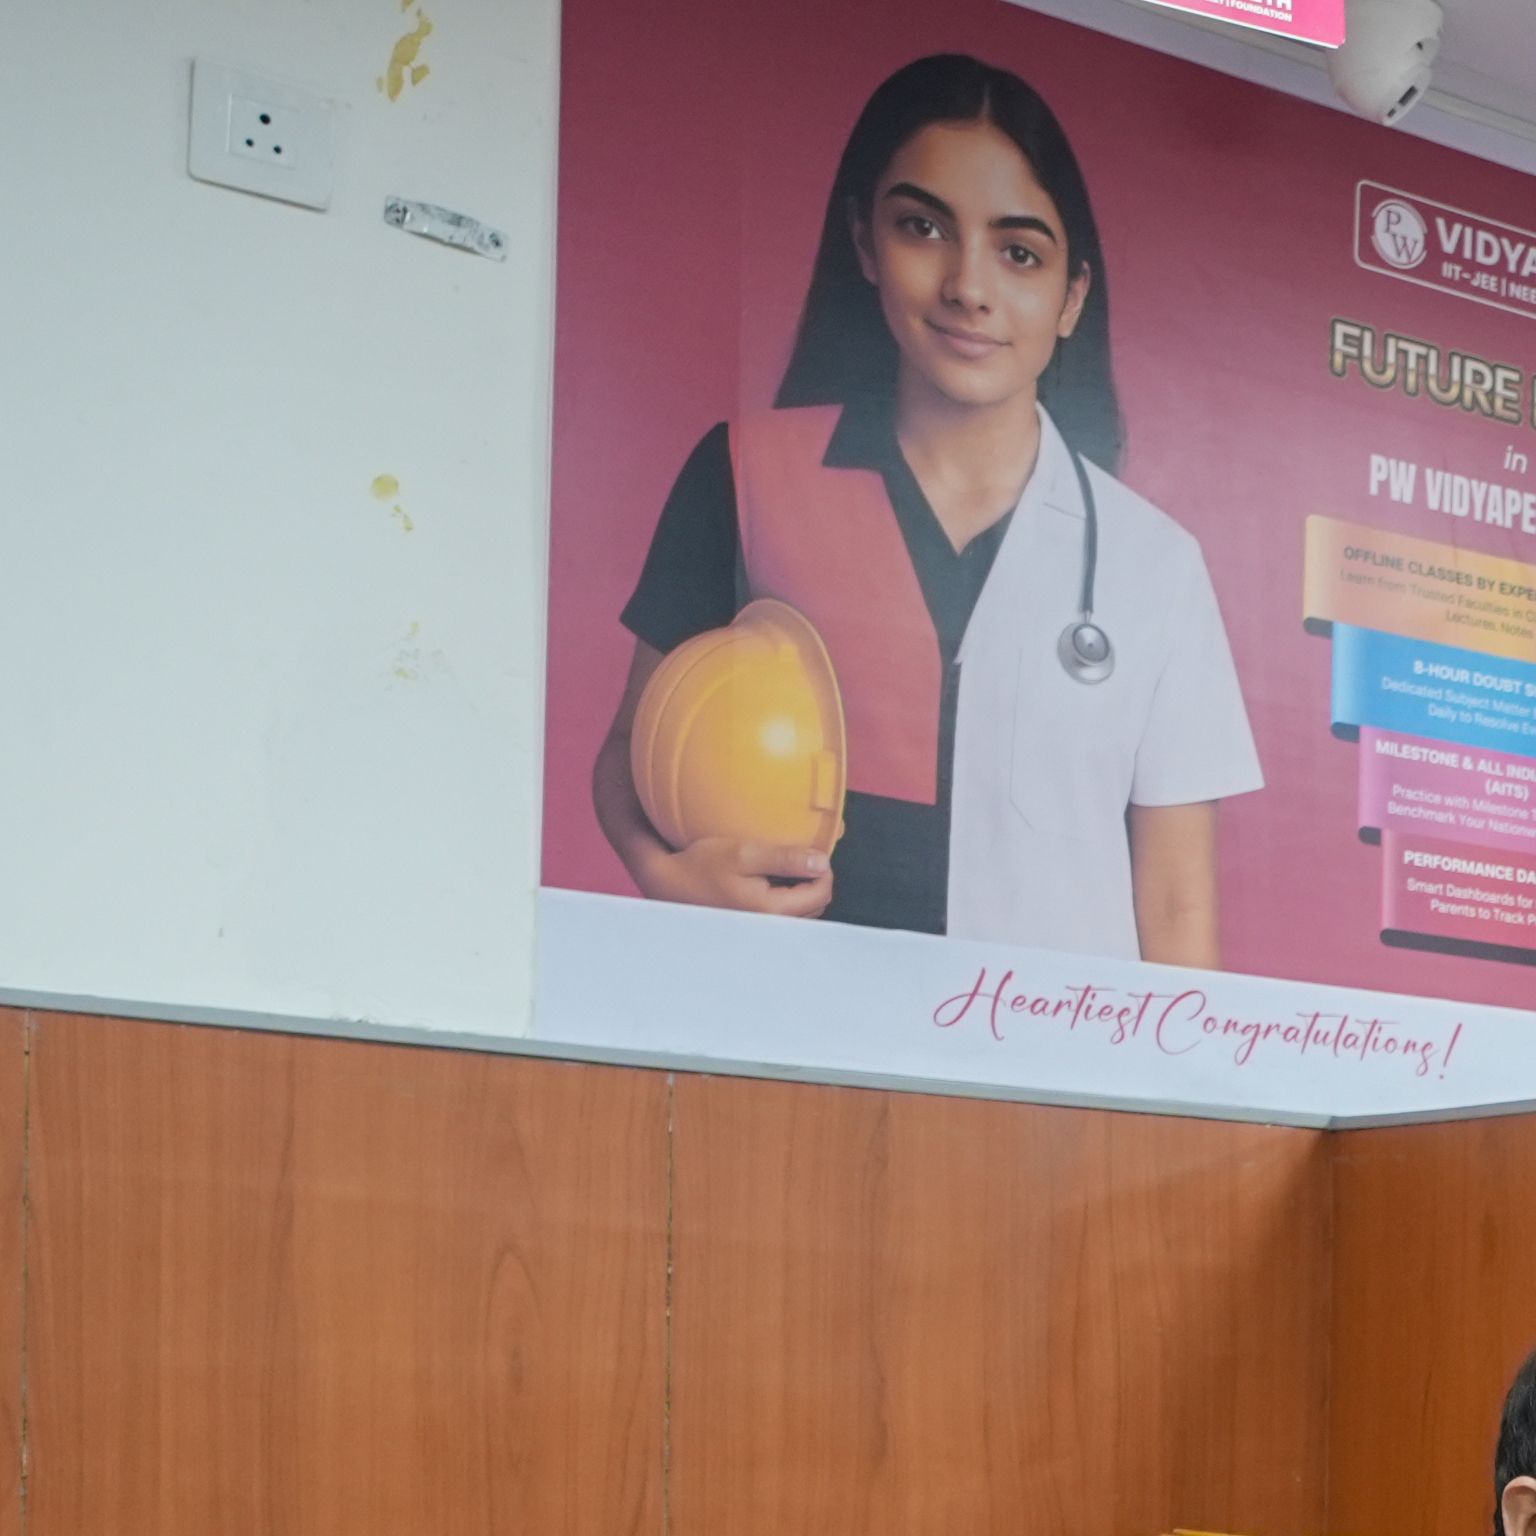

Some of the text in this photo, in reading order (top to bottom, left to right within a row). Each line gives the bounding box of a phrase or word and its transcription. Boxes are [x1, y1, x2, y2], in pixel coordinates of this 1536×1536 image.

[1331, 318, 1522, 424] FUTURE
[1503, 445, 1528, 473] in
[1369, 454, 1416, 504] PW
[1343, 546, 1404, 572] OFFLINE
[1408, 561, 1474, 587] CLASSES
[1477, 576, 1496, 592] BY
[1413, 659, 1470, 684] 8-HOUR
[1472, 672, 1523, 695] DOUBT
[1382, 675, 1443, 700] Dedicated
[1444, 688, 1490, 712] Subject
[1492, 699, 1531, 718] Matter
[1427, 702, 1457, 723] Daily
[1475, 713, 1520, 733] Resolve
[1375, 739, 1459, 769] MILESTONE
[1462, 757, 1474, 772] &
[1477, 759, 1504, 777] ALL
[1392, 783, 1441, 805] Practice
[1444, 793, 1470, 809] with
[1472, 798, 1529, 820] Milestone
[1485, 778, 1530, 802] (AITS)
[1388, 800, 1456, 825] Benchmark
[1458, 812, 1486, 831] Your
[1403, 850, 1515, 882] PERFORMANCE
[1407, 877, 1444, 896] Smart
[1446, 884, 1515, 908] Dashboards
[1517, 893, 1534, 909] for
[1430, 899, 1477, 918] Parents
[1493, 908, 1526, 925] Track
[933, 967, 1463, 1081] Heartiest Congratulations!
